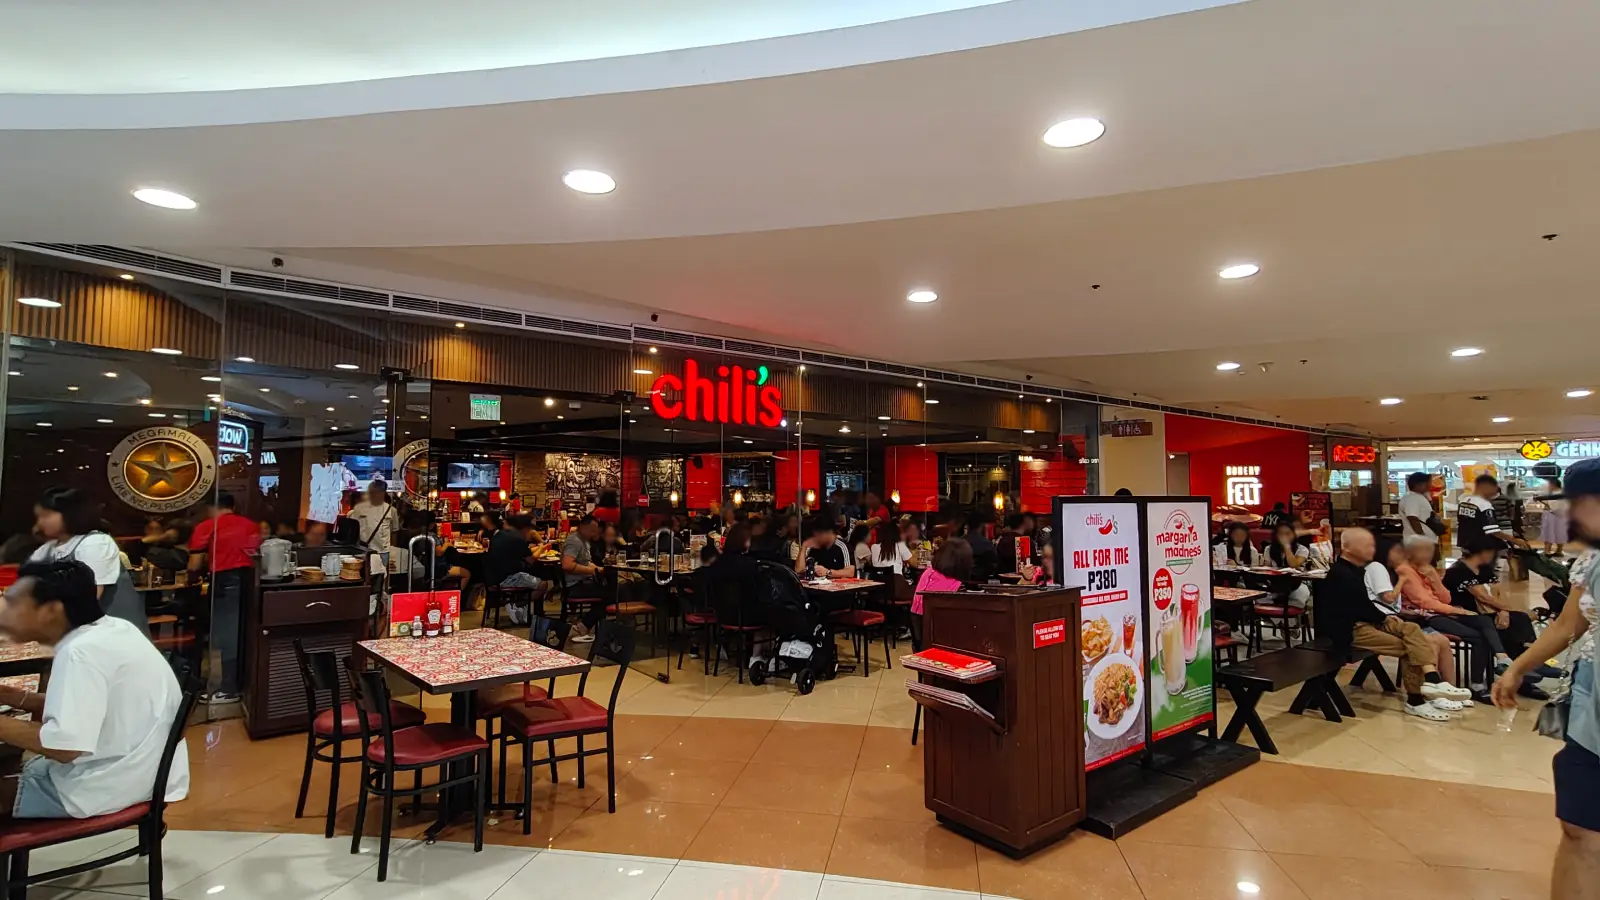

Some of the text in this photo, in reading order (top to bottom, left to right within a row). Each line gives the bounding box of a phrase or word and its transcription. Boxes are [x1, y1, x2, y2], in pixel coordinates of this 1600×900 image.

[651, 358, 783, 427] chili's
[127, 428, 201, 449] MEGAMALL
[111, 475, 131, 499] LIKE
[150, 500, 190, 511] PLACE
[190, 477, 211, 501] ELSE
[1073, 546, 1129, 569] ALL FOR ME
[1165, 544, 1202, 558] madness
[1035, 627, 1048, 635] PLEASE
[1047, 625, 1059, 633] ALLOW
[1044, 632, 1053, 640] SEAT
